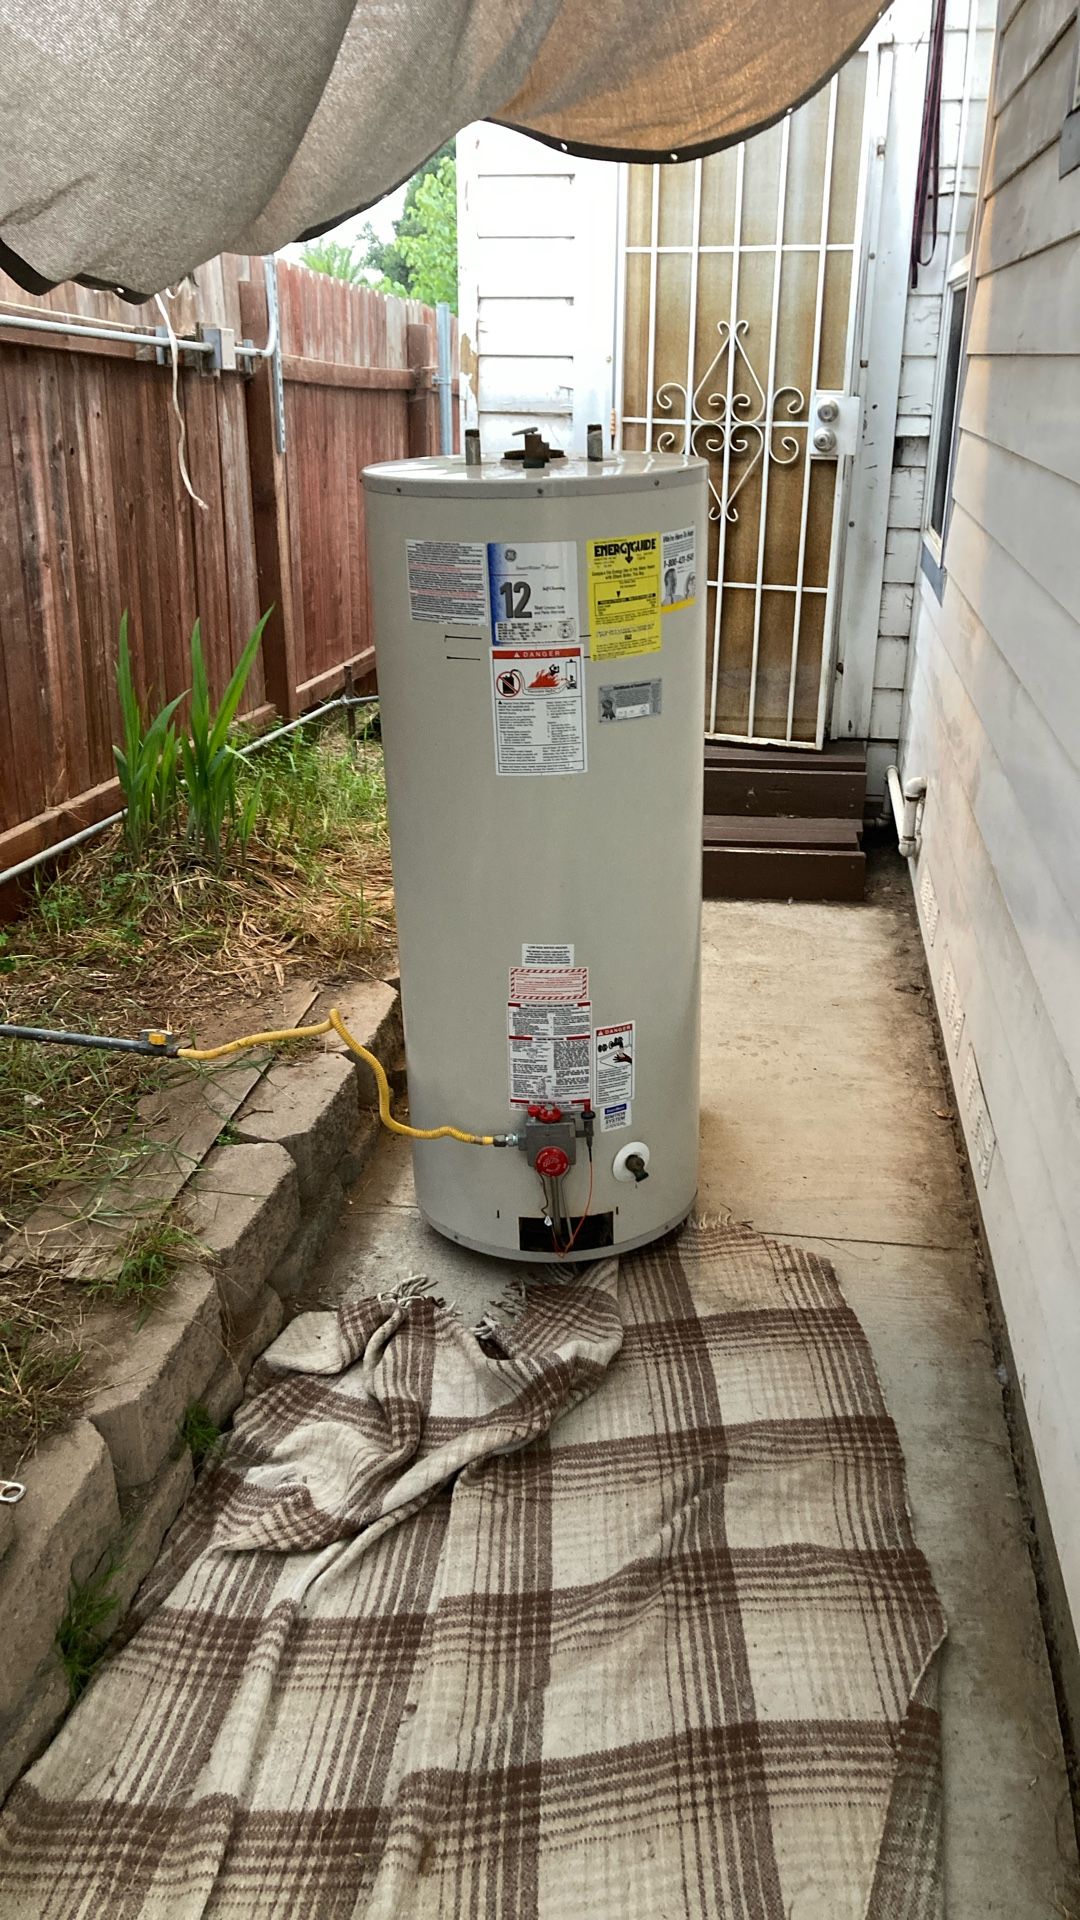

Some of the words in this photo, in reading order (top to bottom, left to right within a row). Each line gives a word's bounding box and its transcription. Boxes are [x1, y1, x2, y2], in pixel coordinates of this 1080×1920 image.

[500, 581, 532, 618] 12
[523, 650, 561, 658] DANGER
[604, 1025, 632, 1035] DANGER
